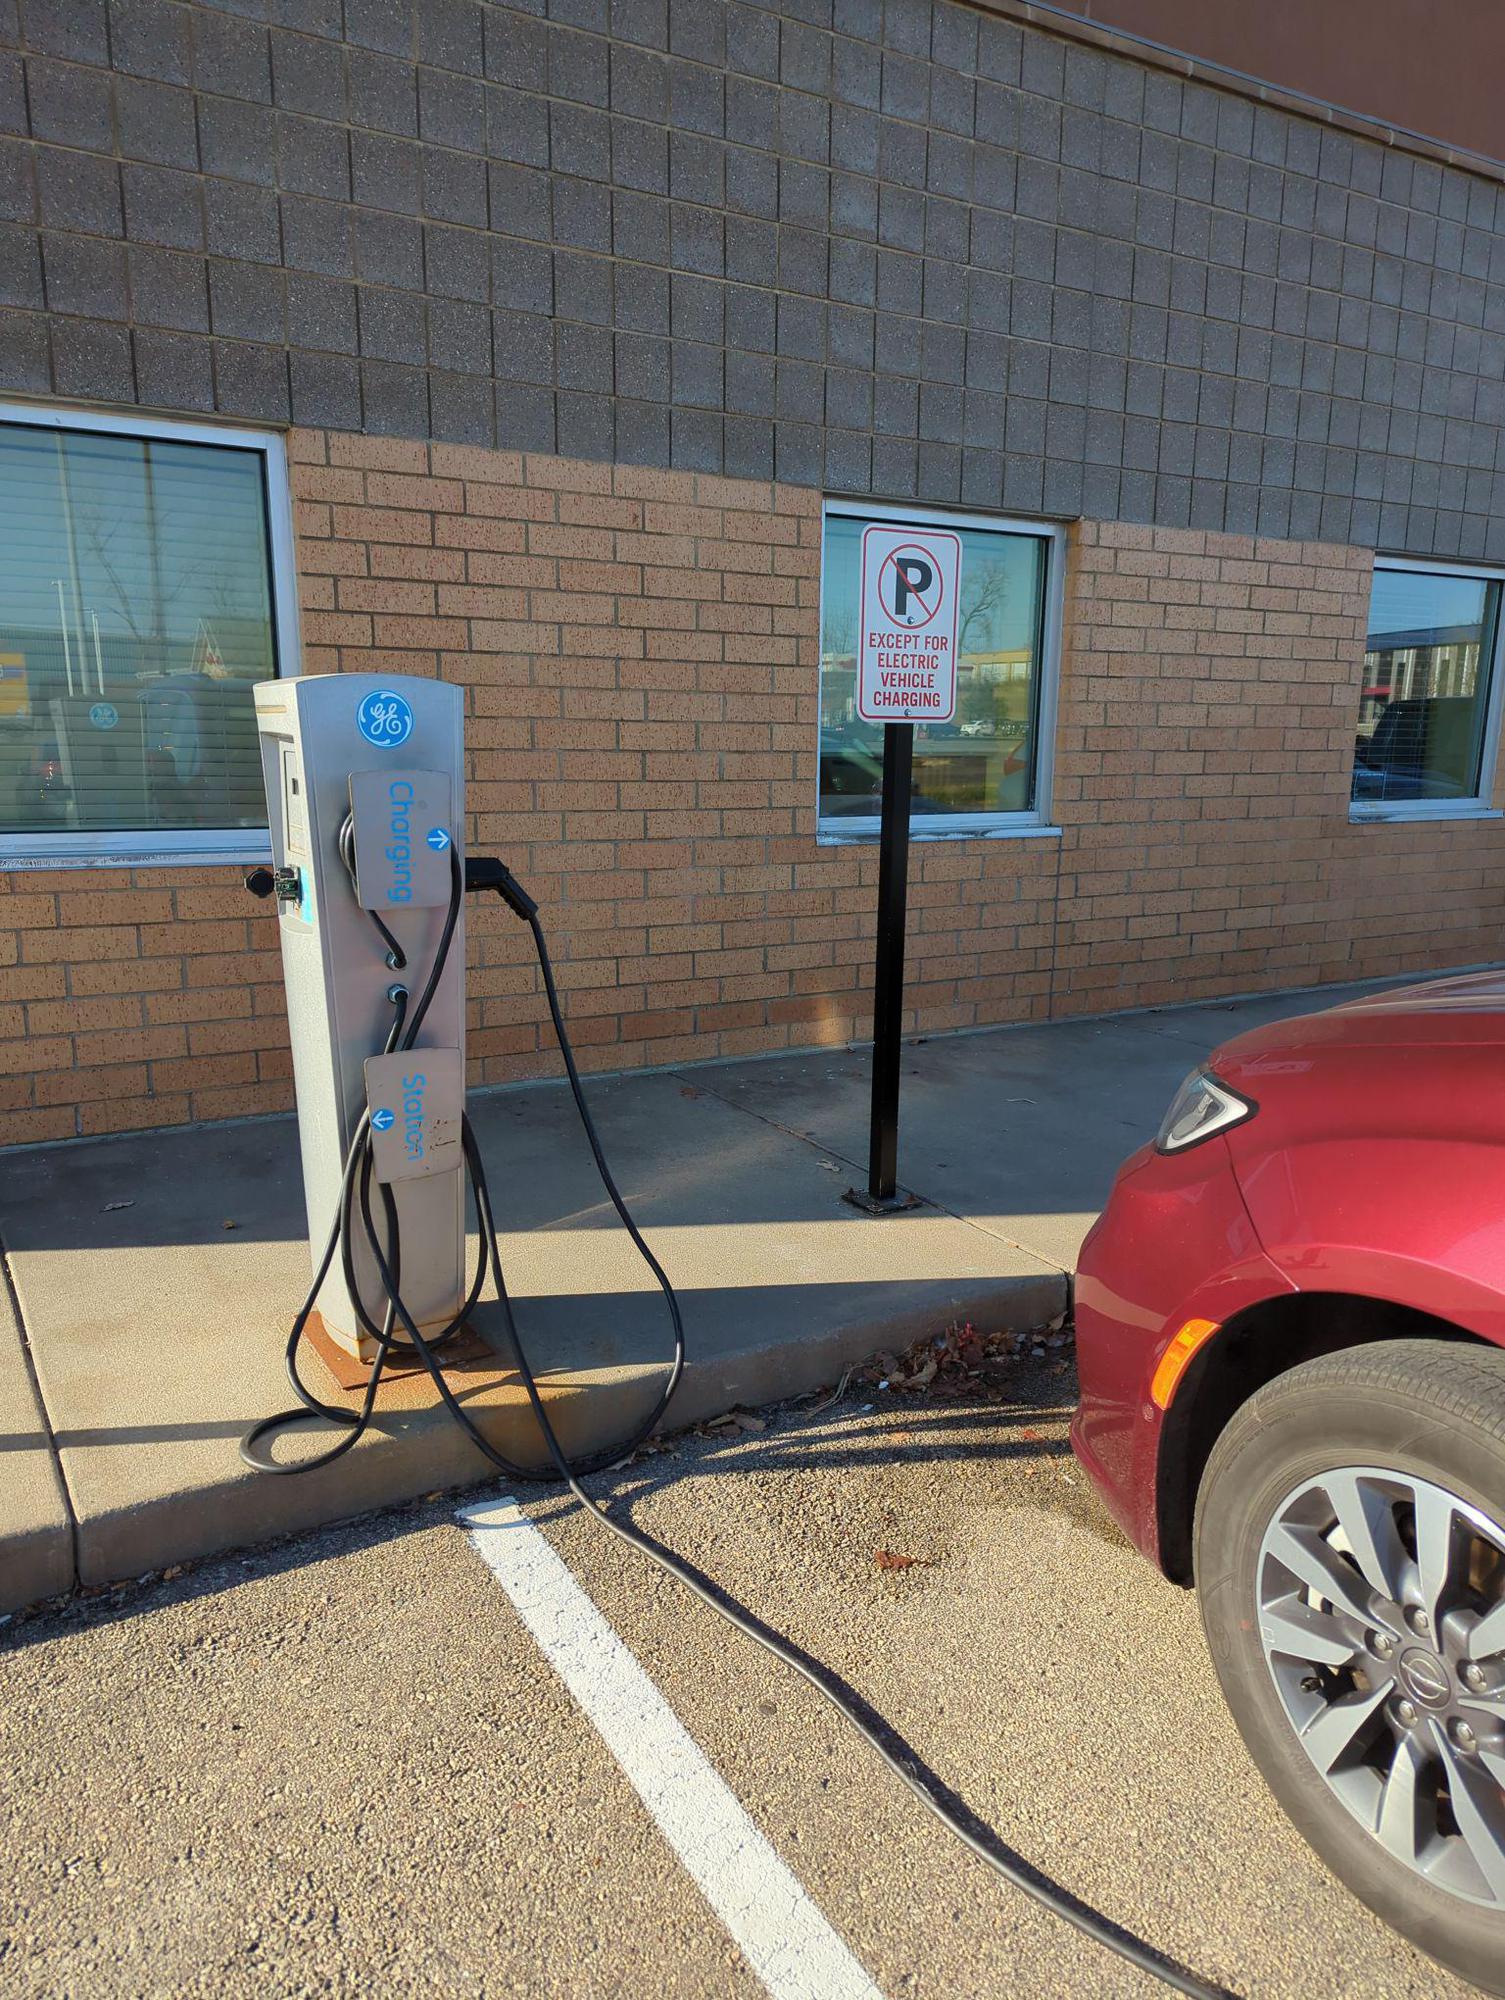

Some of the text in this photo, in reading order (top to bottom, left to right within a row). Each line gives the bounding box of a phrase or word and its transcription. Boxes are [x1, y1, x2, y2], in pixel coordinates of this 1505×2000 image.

[895, 557, 933, 616] P
[869, 632, 948, 651] EXCEPT FOR
[877, 653, 939, 670] ELECTRIC
[881, 672, 935, 688] VEHICLE
[873, 691, 941, 707] CHARGING
[386, 780, 415, 903] Charging
[402, 1073, 427, 1161] Station
